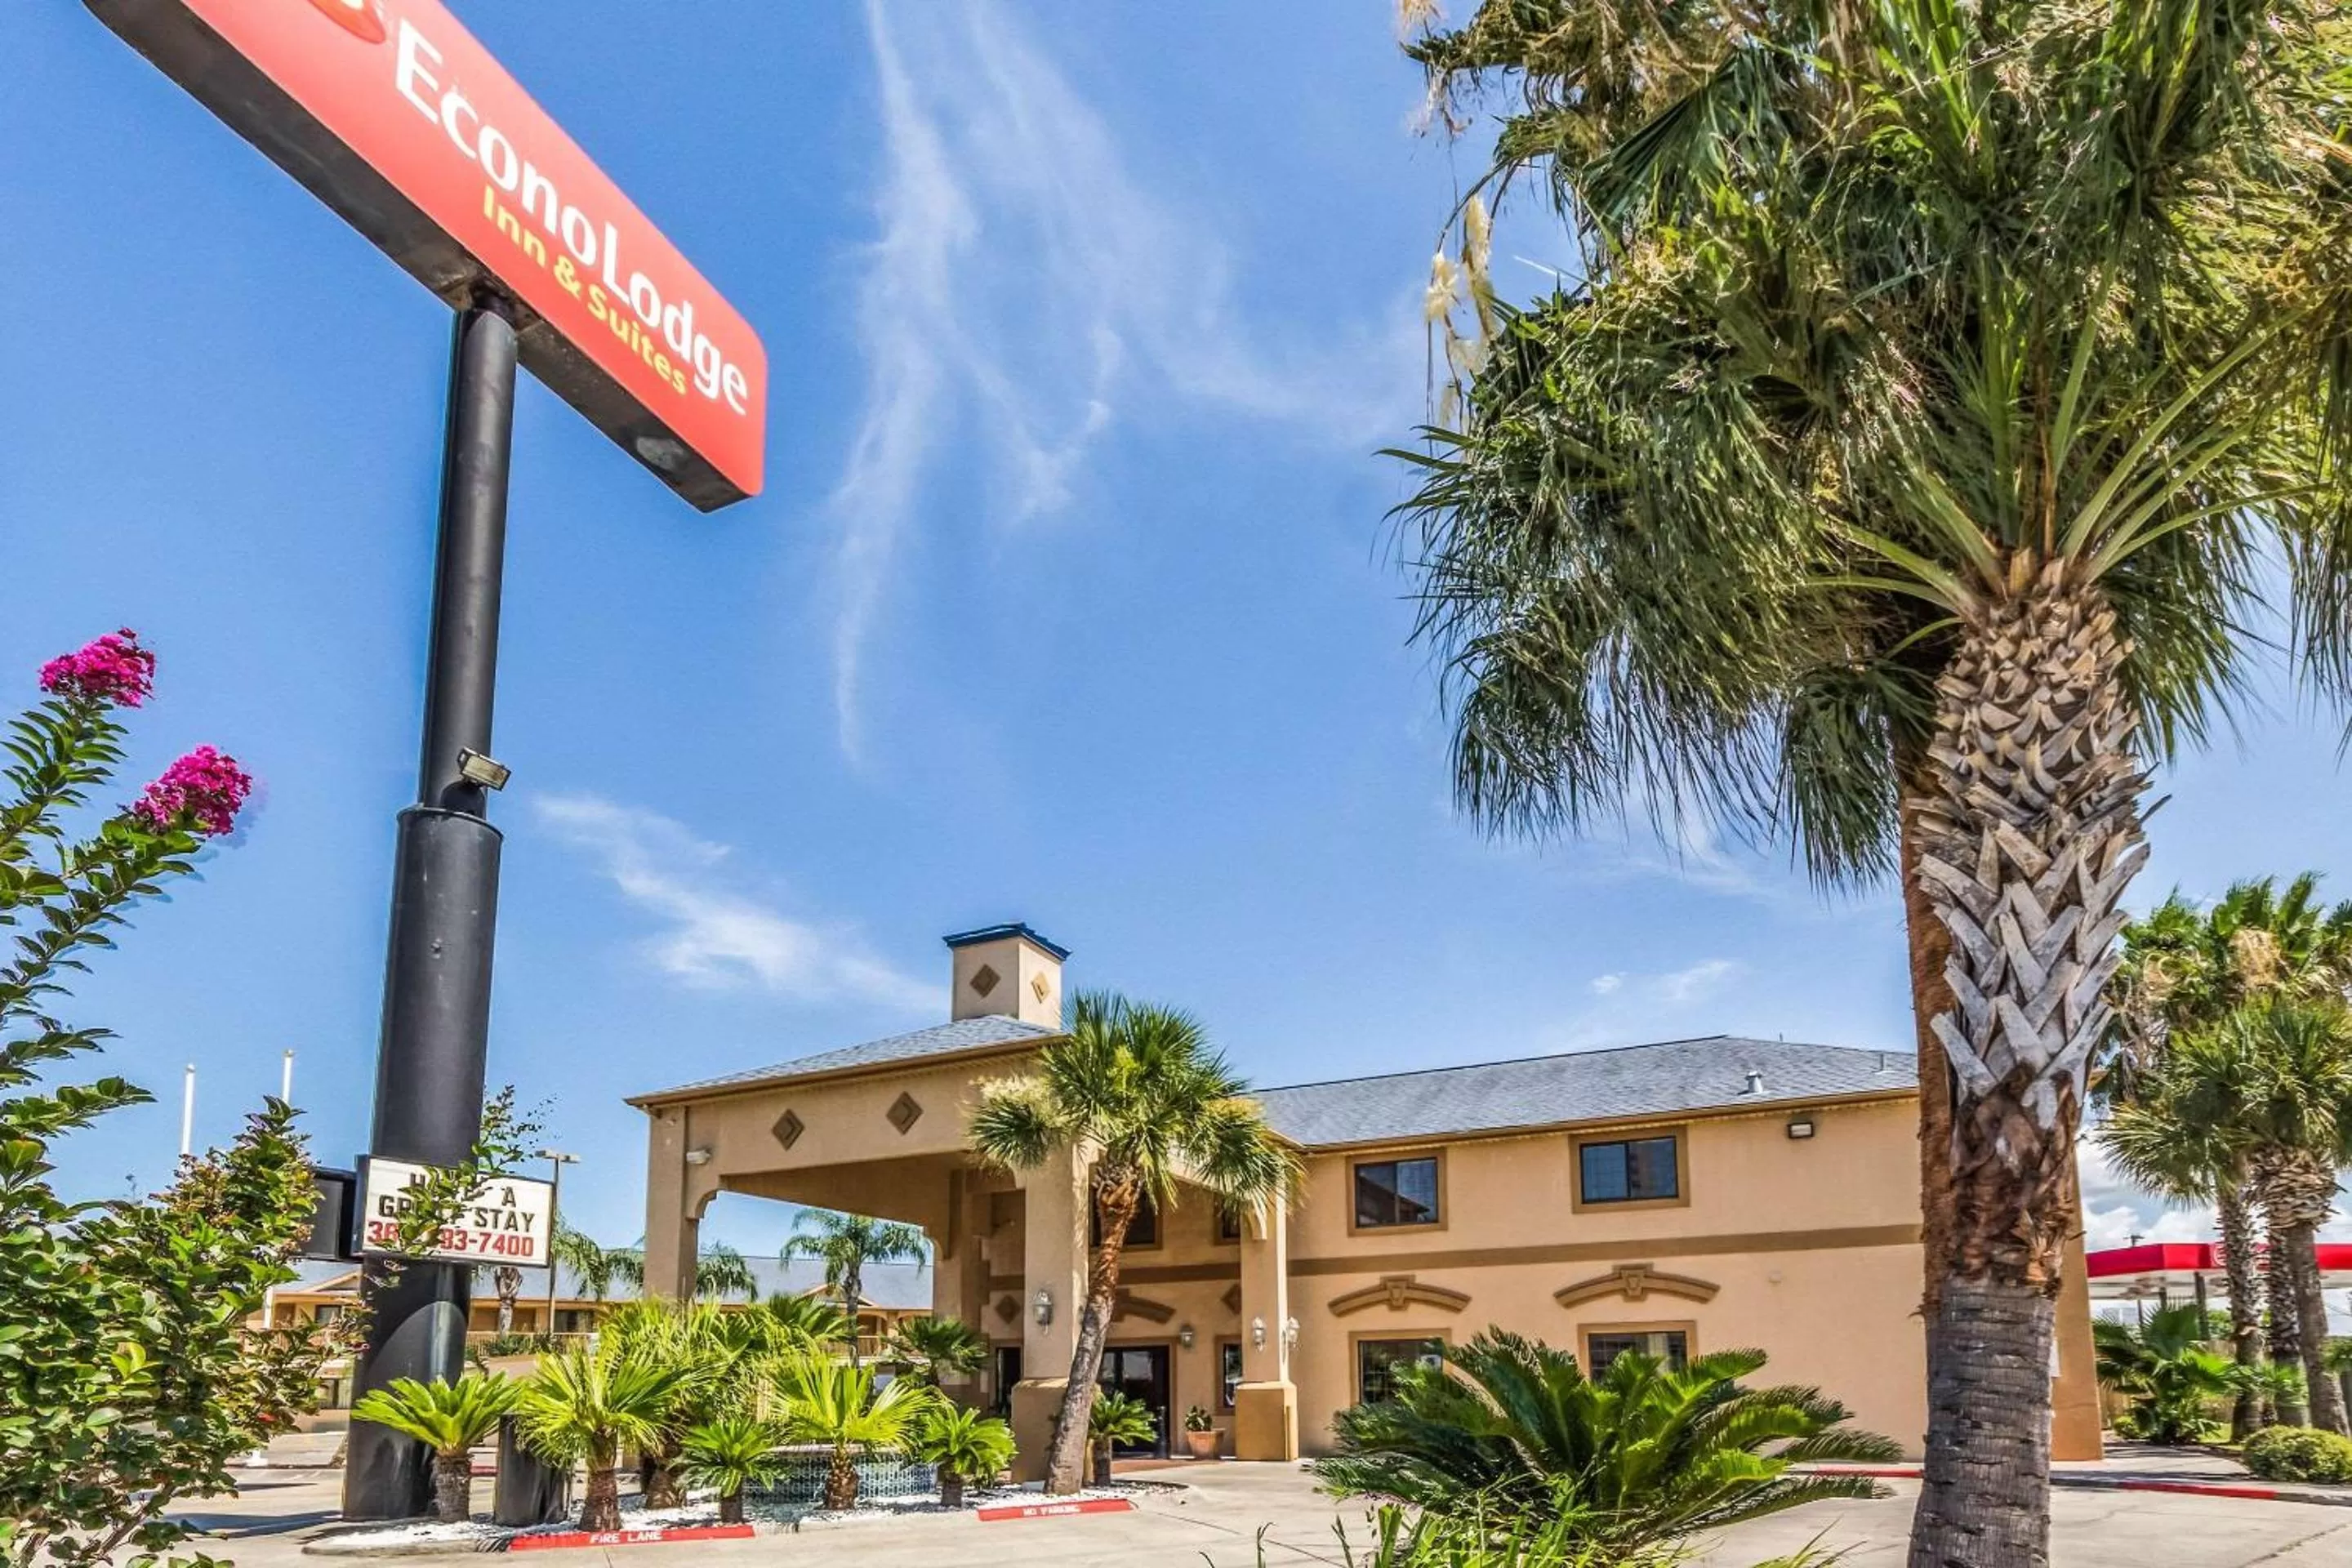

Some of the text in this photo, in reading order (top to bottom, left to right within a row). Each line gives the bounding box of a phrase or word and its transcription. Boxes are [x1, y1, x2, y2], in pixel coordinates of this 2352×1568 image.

[483, 185, 688, 396] Inn & Suites
[501, 1186, 516, 1208] A
[474, 1207, 535, 1232] STAY
[1022, 1507, 1037, 1517] NO
[589, 1530, 663, 1544] FIRE LANE
